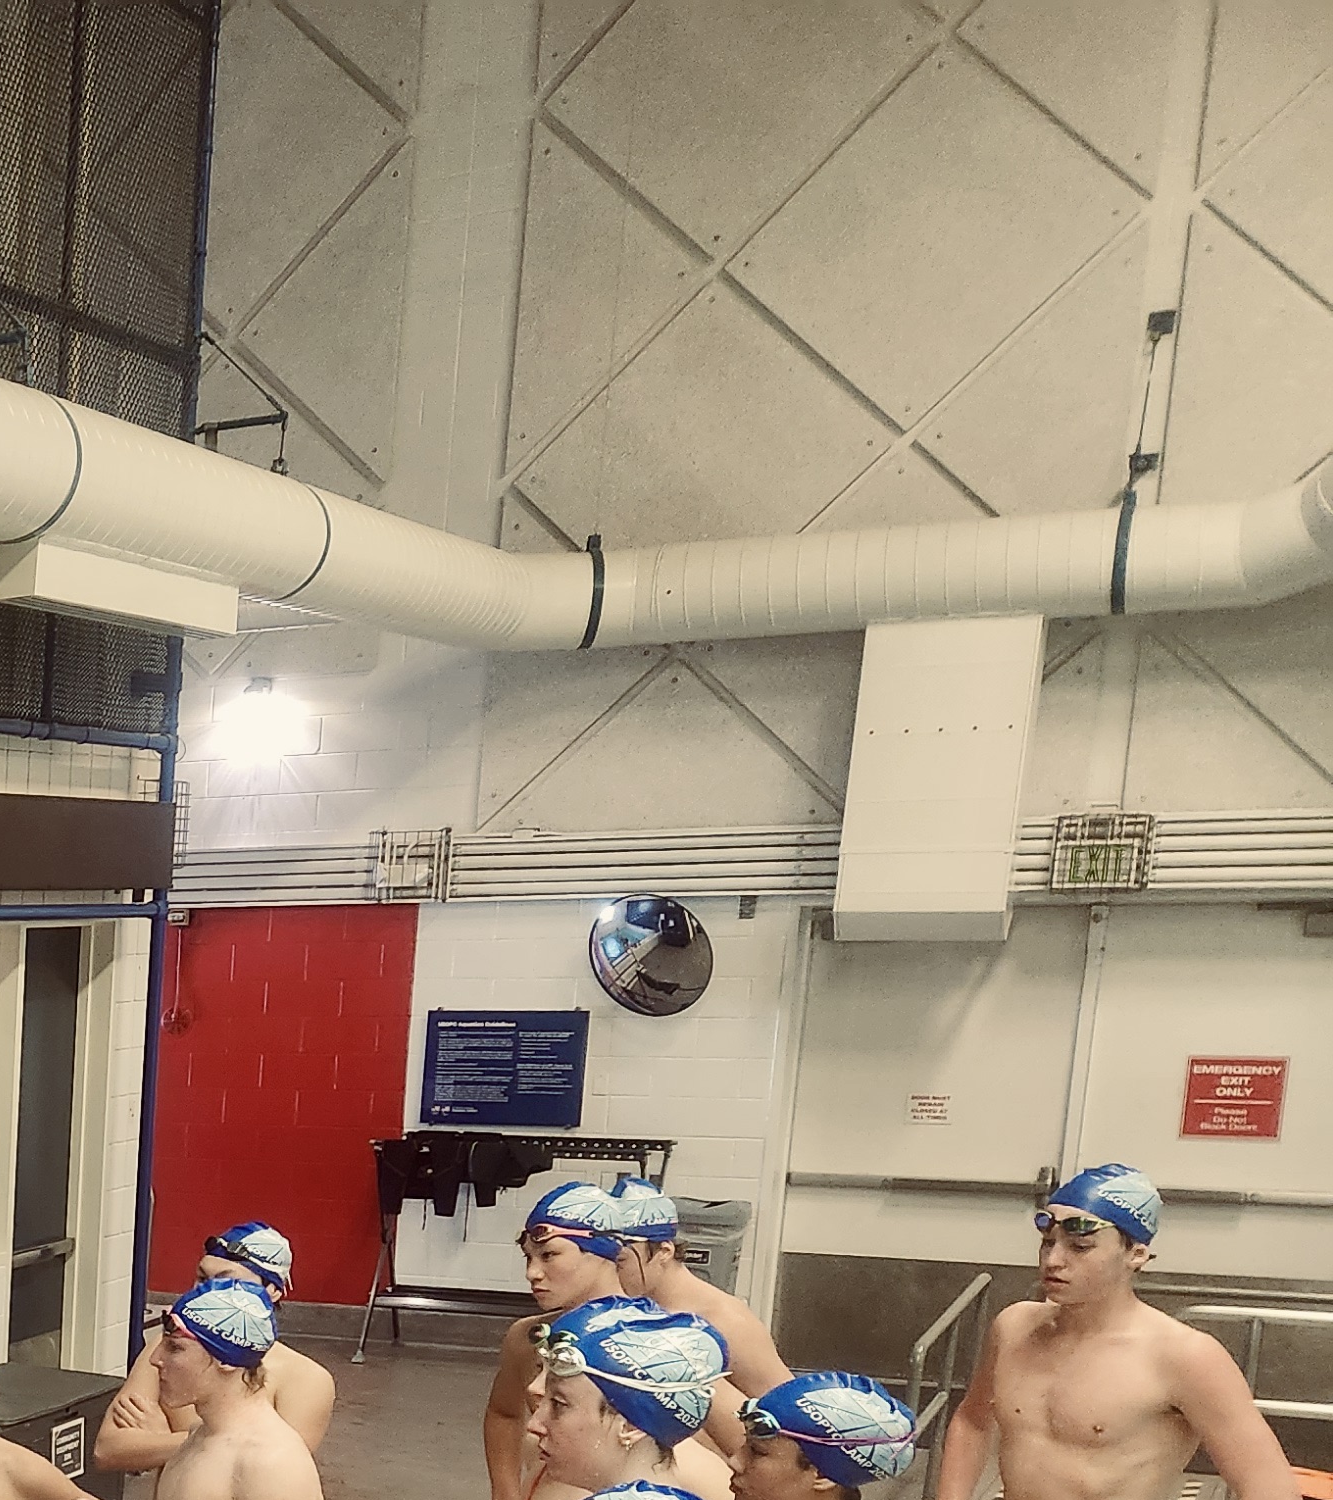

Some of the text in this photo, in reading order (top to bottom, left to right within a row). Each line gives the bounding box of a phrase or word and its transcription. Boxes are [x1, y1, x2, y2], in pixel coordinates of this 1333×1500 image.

[1069, 845, 1123, 883] EXIT
[1194, 1065, 1281, 1075] EMERGENCY
[1221, 1076, 1251, 1085] EXIT
[1216, 1087, 1253, 1096] ONLY
[546, 1209, 592, 1227] USOPTC
[1098, 1189, 1142, 1219] USOPTC
[181, 1307, 251, 1348] USOPTC CAMP
[599, 1339, 701, 1429] USOPTC 2025
[796, 1397, 872, 1468] USOPTC CAMP
